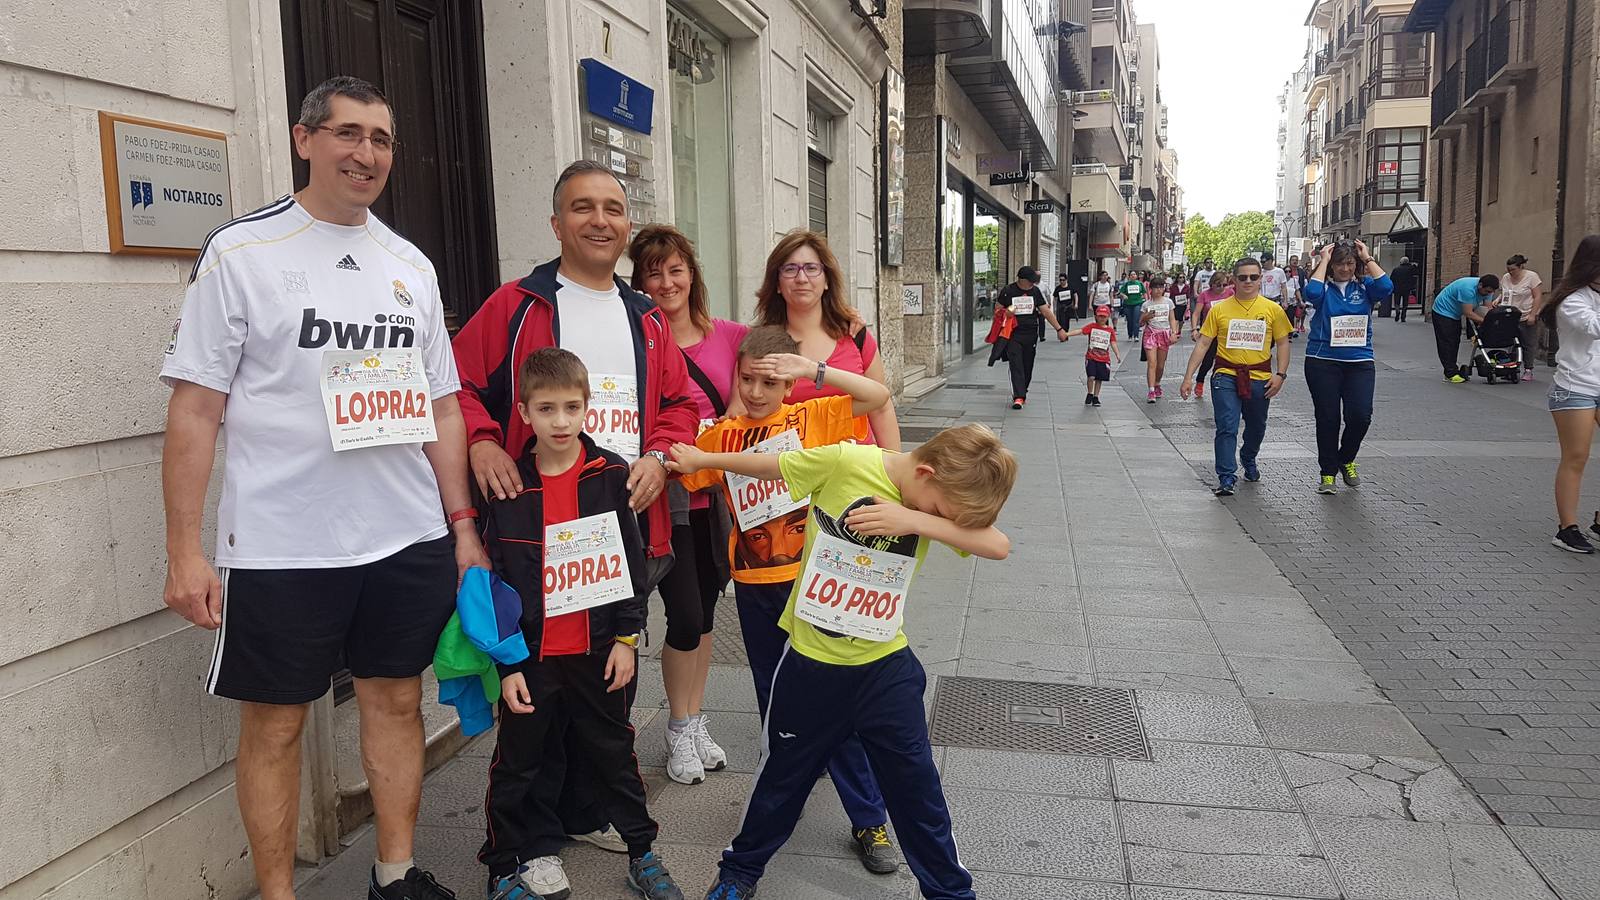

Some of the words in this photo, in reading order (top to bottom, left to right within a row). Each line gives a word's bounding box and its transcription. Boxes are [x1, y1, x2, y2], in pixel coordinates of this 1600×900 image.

[603, 22, 610, 54] 7
[124, 135, 148, 148] PABLO
[150, 139, 192, 154] FDEZ-PRIDA
[194, 146, 220, 160] CASADO
[126, 150, 154, 163] CARMEN
[156, 154, 196, 168] FDEZ-PRIDA
[197, 162, 222, 173] CASADO
[164, 188, 223, 207] NOTARIOS
[336, 263, 361, 272] adidas
[298, 308, 415, 350] bwin
[388, 313, 415, 326] com
[336, 389, 426, 425] LOSPRA2
[582, 408, 606, 434] OS
[611, 408, 640, 434] PRO
[738, 478, 790, 512] LOSPR
[544, 554, 622, 594] OSPRA2
[805, 572, 848, 608] LOS
[844, 586, 901, 621] PROS
